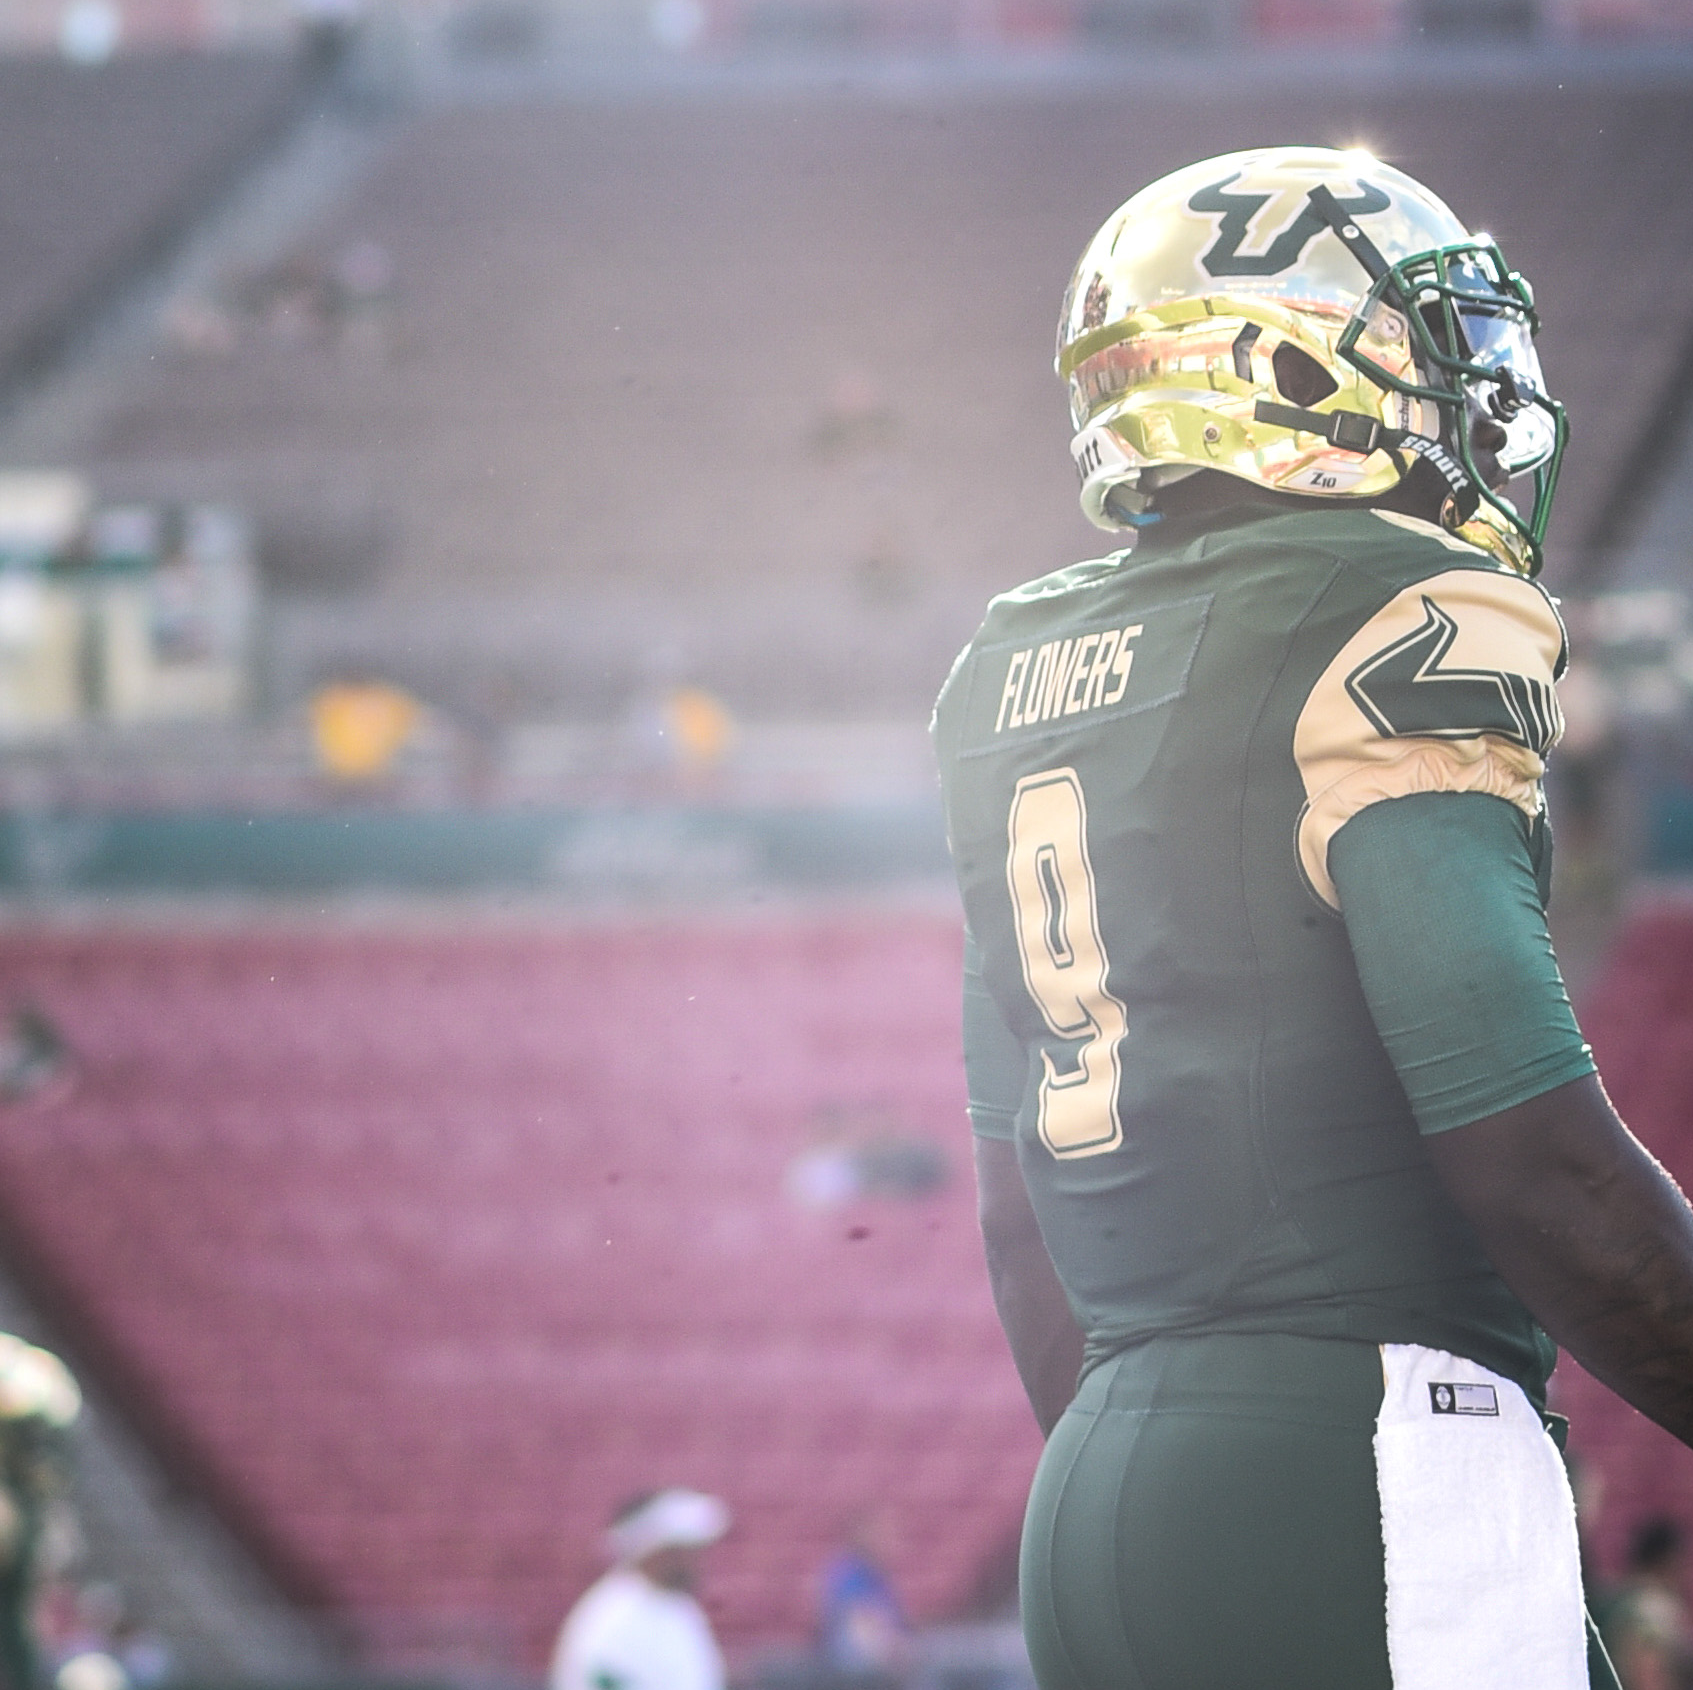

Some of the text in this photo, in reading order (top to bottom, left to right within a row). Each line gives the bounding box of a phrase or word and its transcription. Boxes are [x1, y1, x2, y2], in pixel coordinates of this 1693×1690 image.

[1400, 435, 1469, 493] schutt
[995, 624, 1143, 734] FLOWERS
[1007, 767, 1128, 1161] 9
